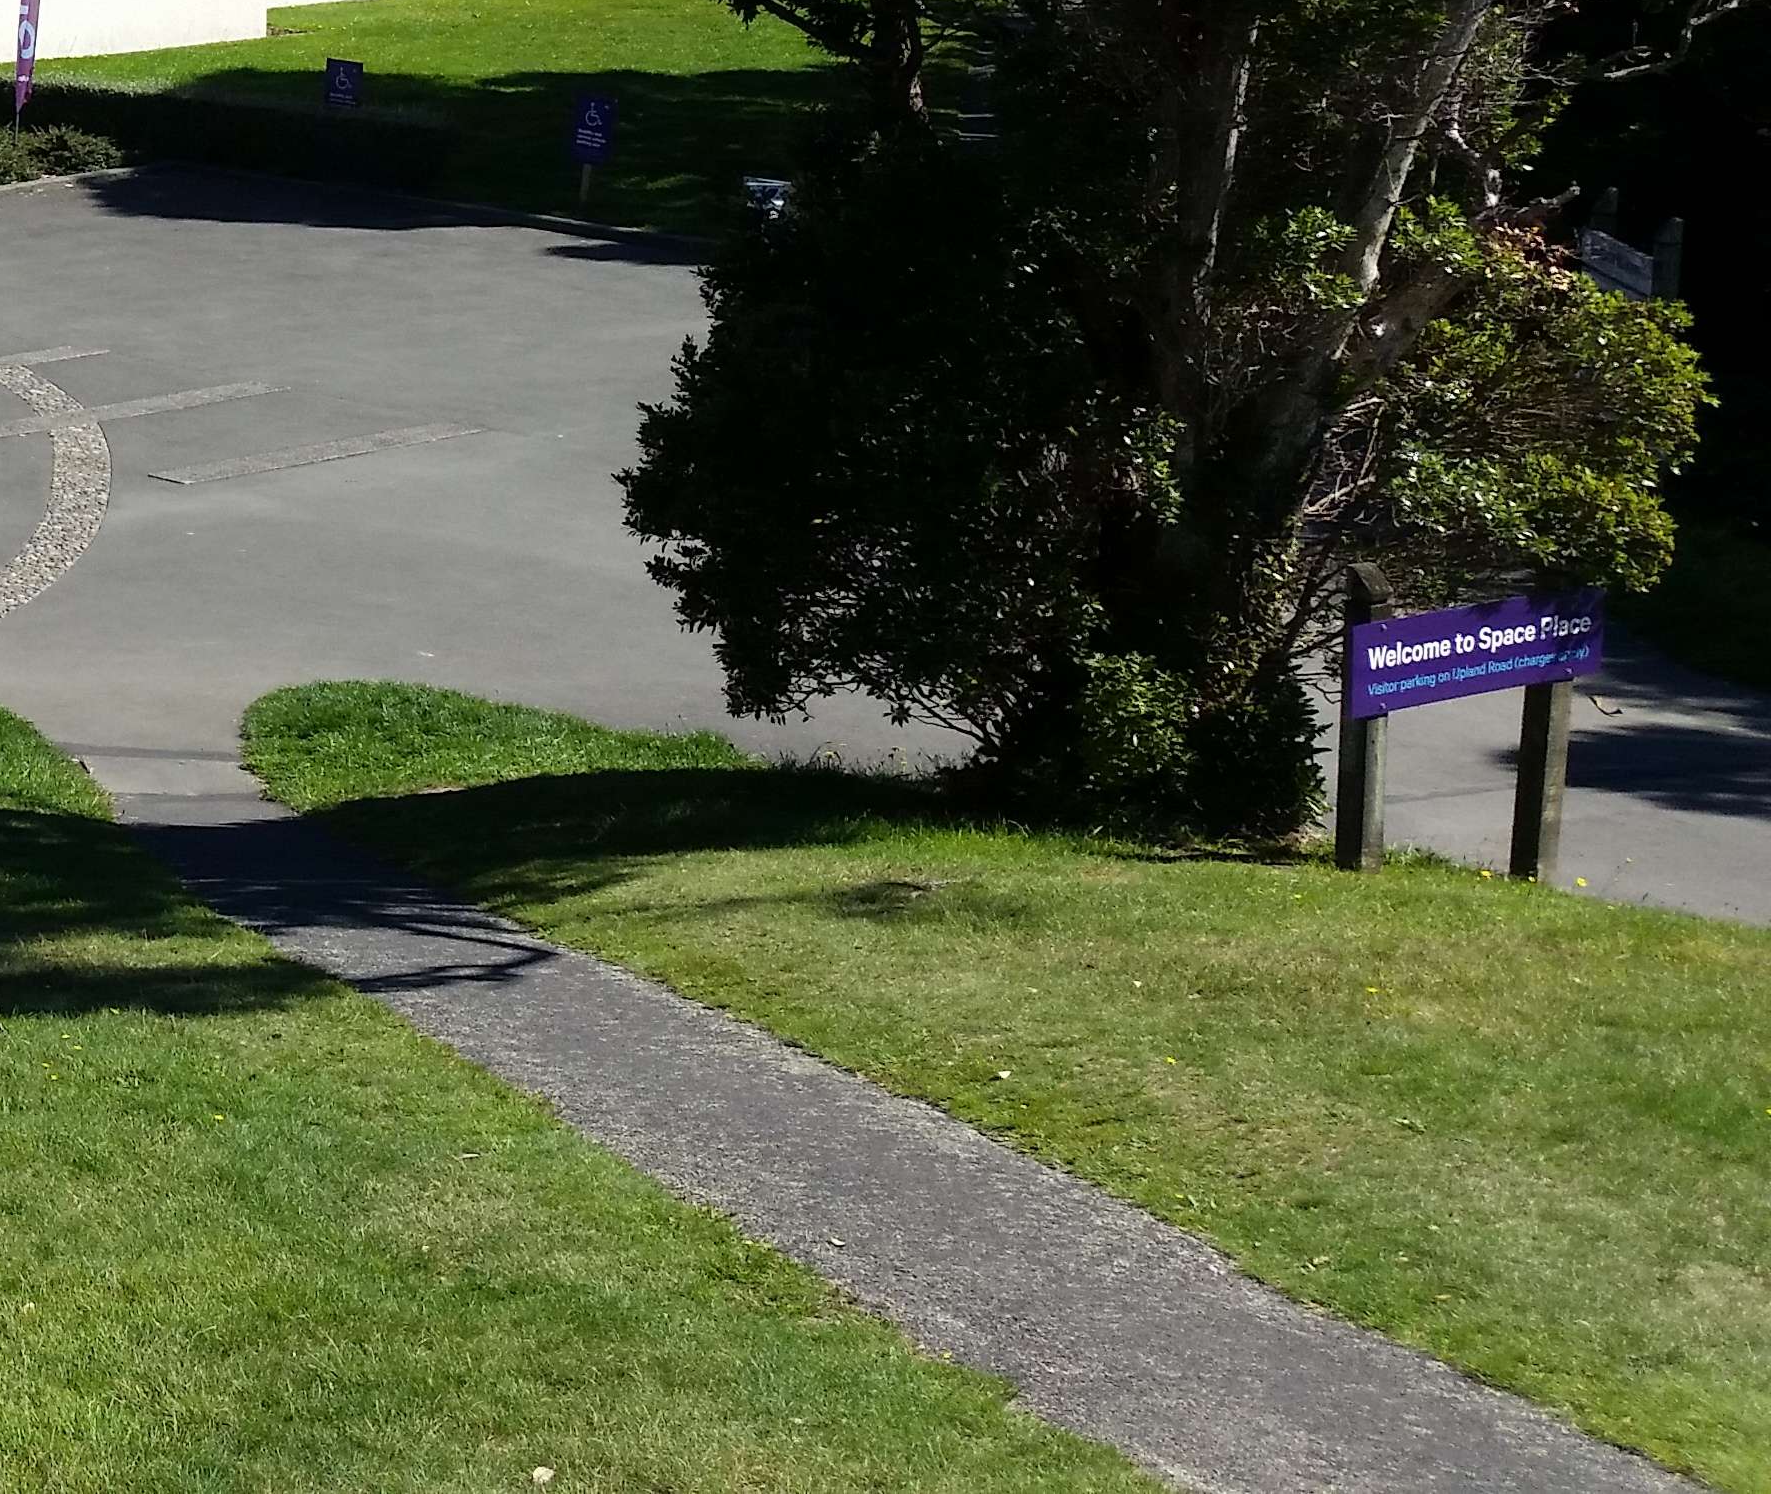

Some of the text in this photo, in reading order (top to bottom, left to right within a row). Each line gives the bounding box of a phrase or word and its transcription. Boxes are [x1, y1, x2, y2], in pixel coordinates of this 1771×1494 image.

[1367, 615, 1592, 671] Welcome to Space Place
[1367, 681, 1400, 696] Visitor
[1400, 674, 1437, 693] parking
[1437, 671, 1451, 683] on
[1452, 664, 1486, 682] Upland
[1488, 659, 1513, 674] Road
